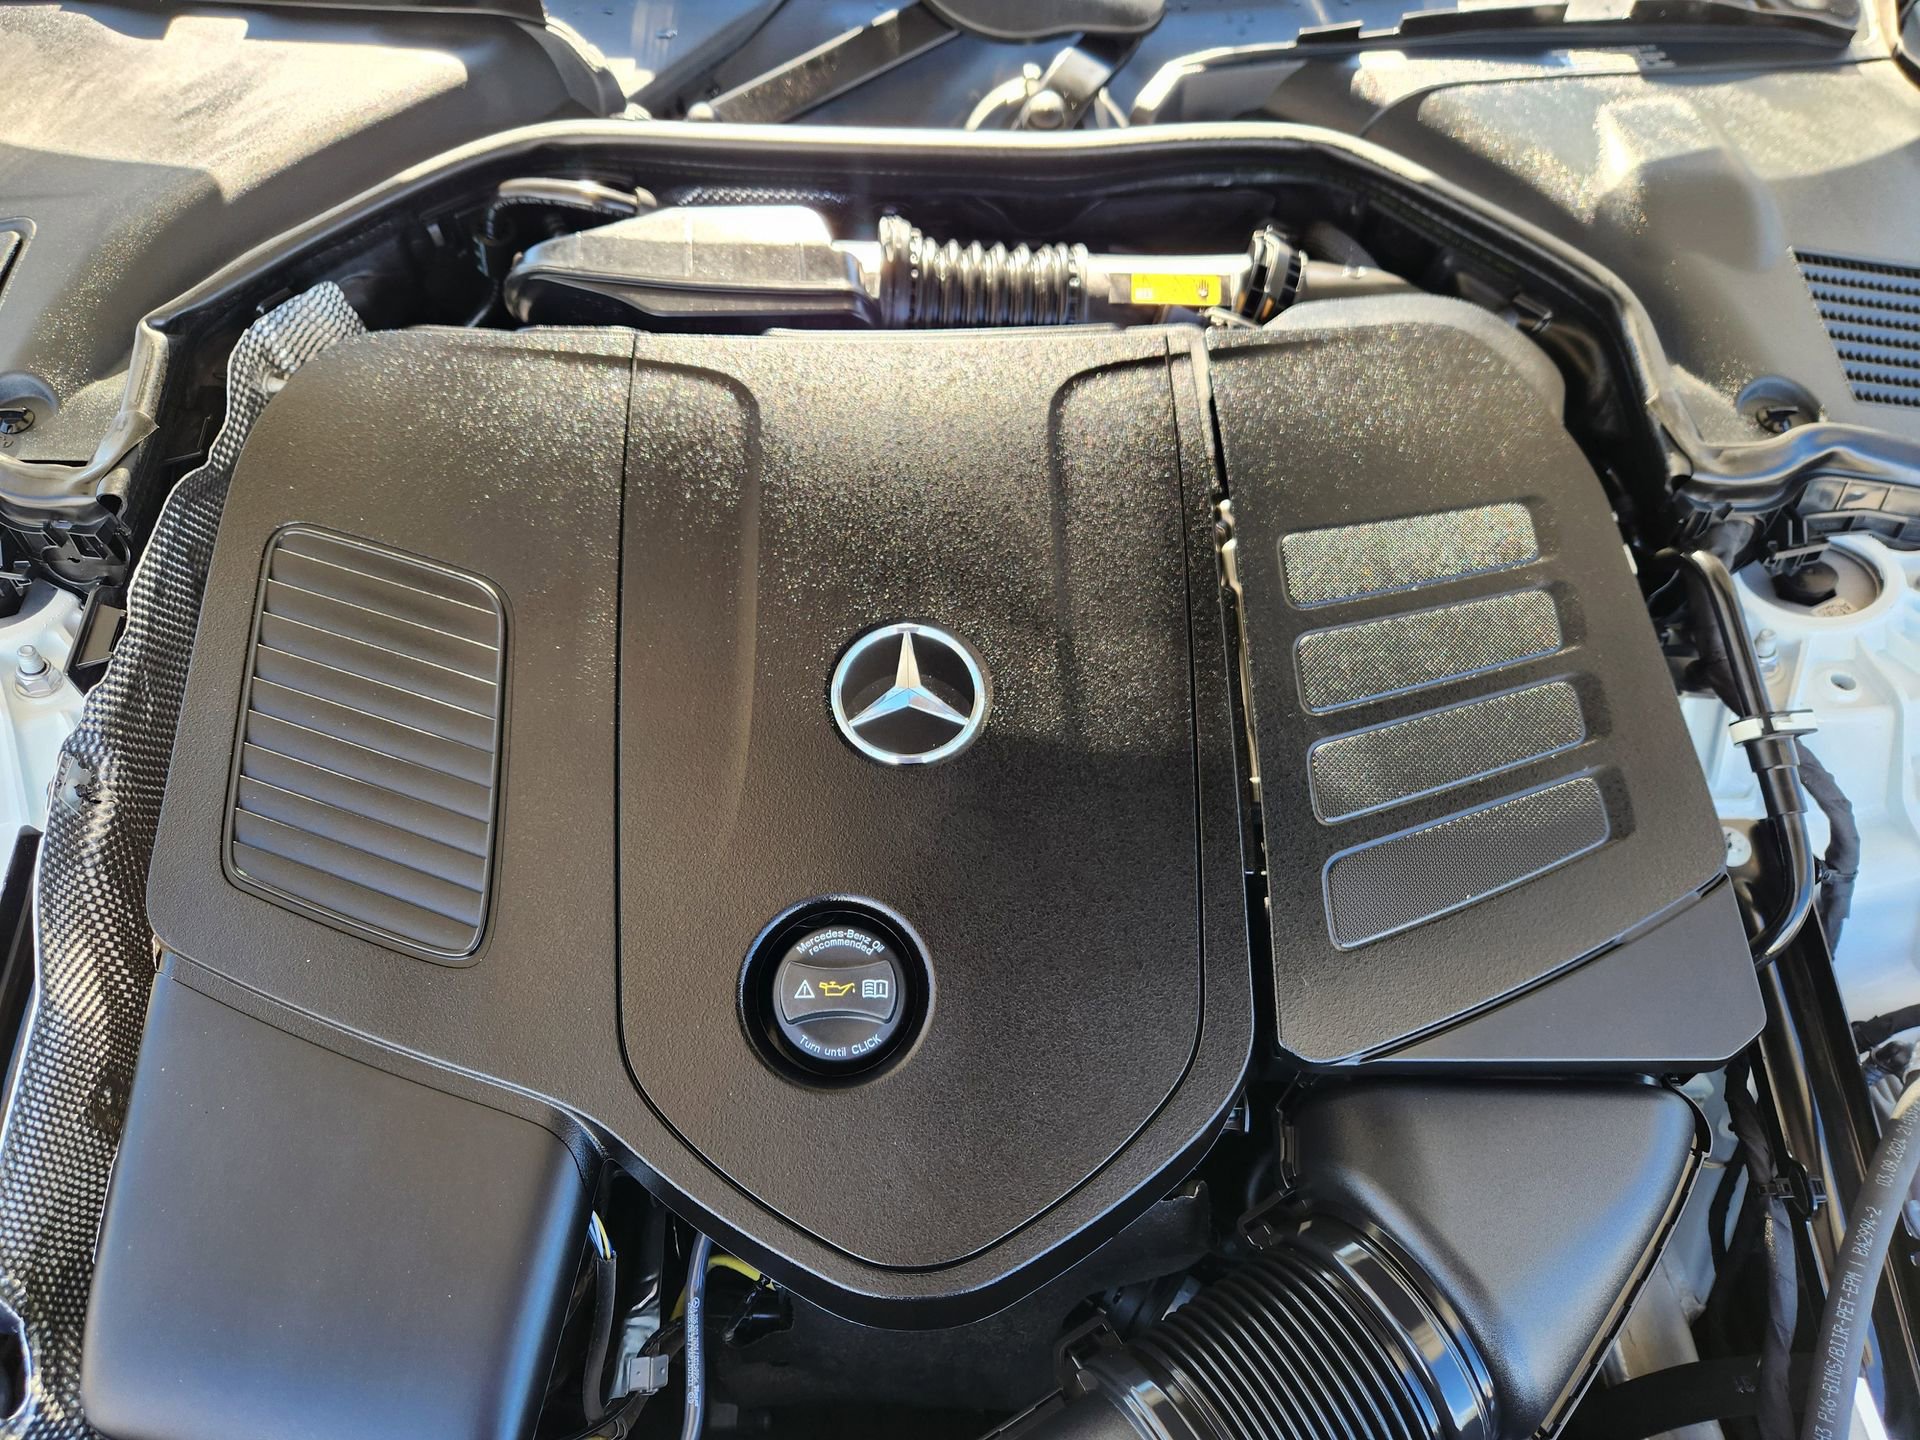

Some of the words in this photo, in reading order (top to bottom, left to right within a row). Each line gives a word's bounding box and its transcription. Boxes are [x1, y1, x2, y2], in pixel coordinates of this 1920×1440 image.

[796, 929, 872, 954] Mercedes-Benz
[872, 940, 885, 953] Oil
[809, 939, 874, 956] recommended
[800, 1034, 821, 1053] Turn
[824, 1047, 847, 1056] until
[851, 1033, 882, 1054] CLICK
